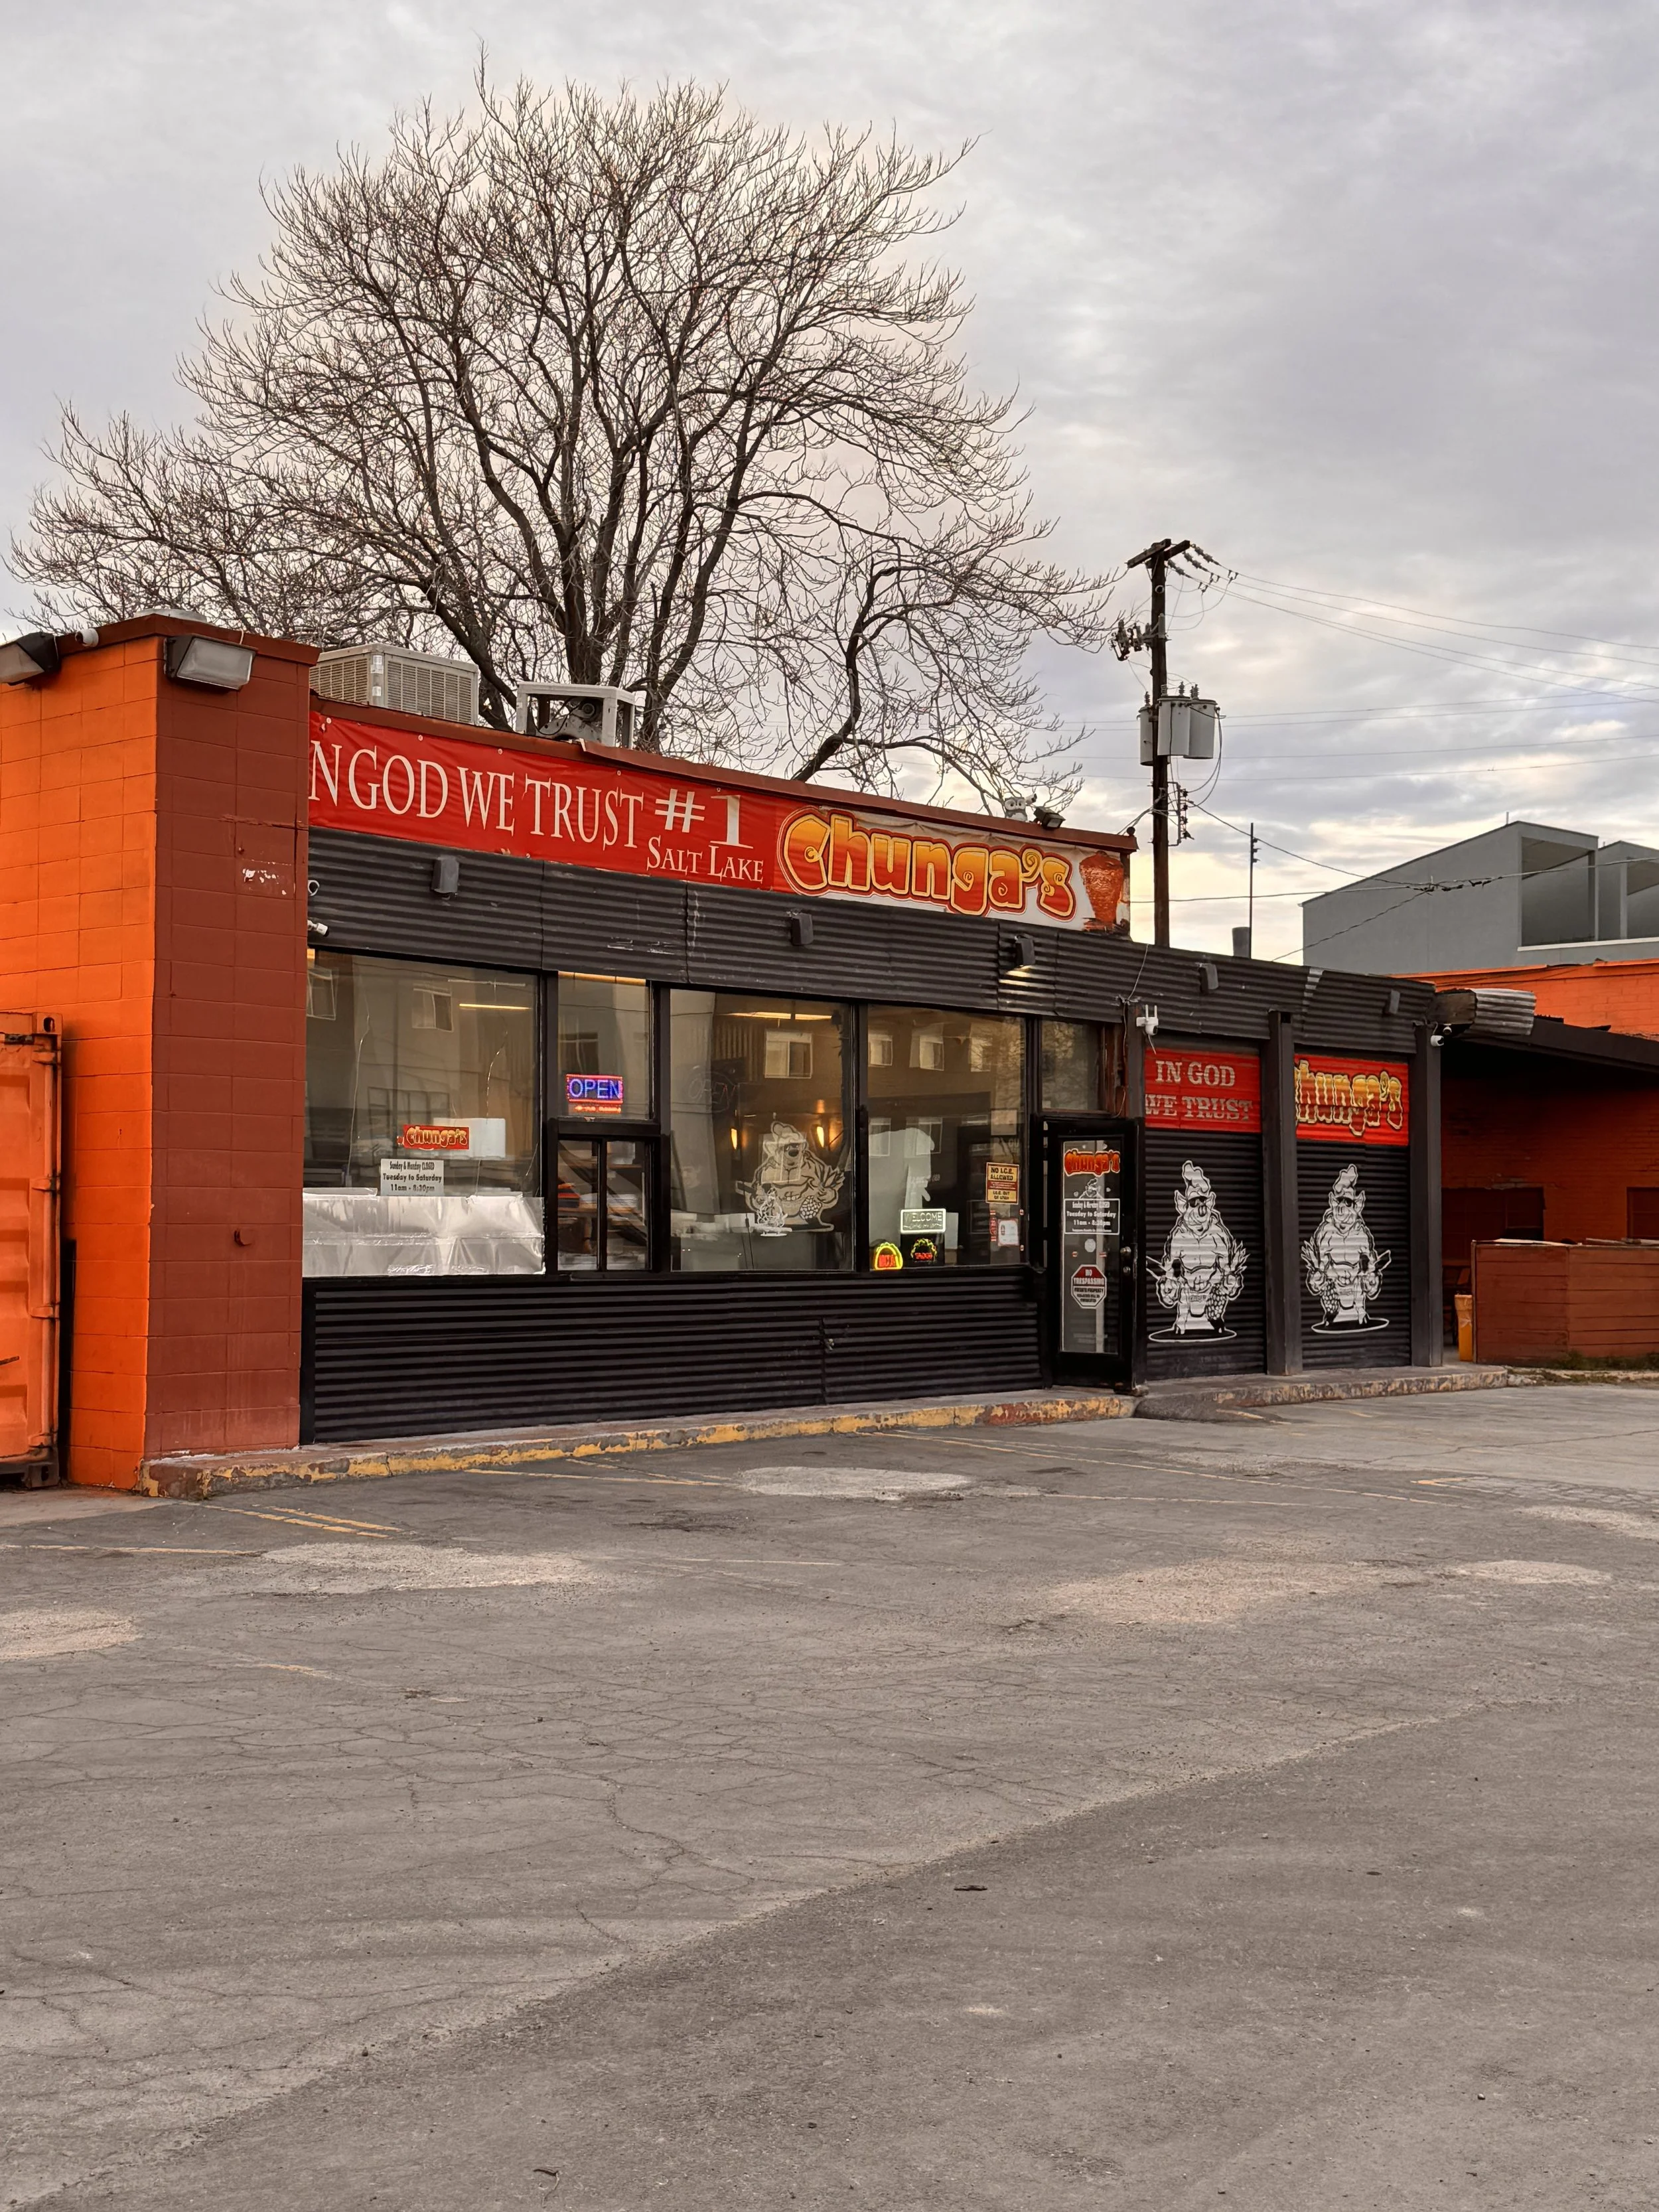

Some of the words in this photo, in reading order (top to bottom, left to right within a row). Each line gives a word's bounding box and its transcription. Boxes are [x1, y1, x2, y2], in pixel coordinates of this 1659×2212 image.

[348, 745, 449, 818] GOD
[457, 766, 515, 838] WE
[524, 773, 644, 851] TRUST
[654, 788, 754, 849] #1
[782, 810, 1075, 918] Chunga's
[1155, 1060, 1183, 1083] IN
[1187, 1061, 1236, 1086] GOD
[569, 1078, 622, 1099] OPEN
[1145, 1094, 1178, 1116] WE
[1182, 1096, 1253, 1120] TRUST
[406, 1126, 468, 1147] Chunga's
[383, 1173, 407, 1182] Tuesday
[416, 1174, 442, 1183] Saturday
[390, 1161, 403, 1172] Sunday
